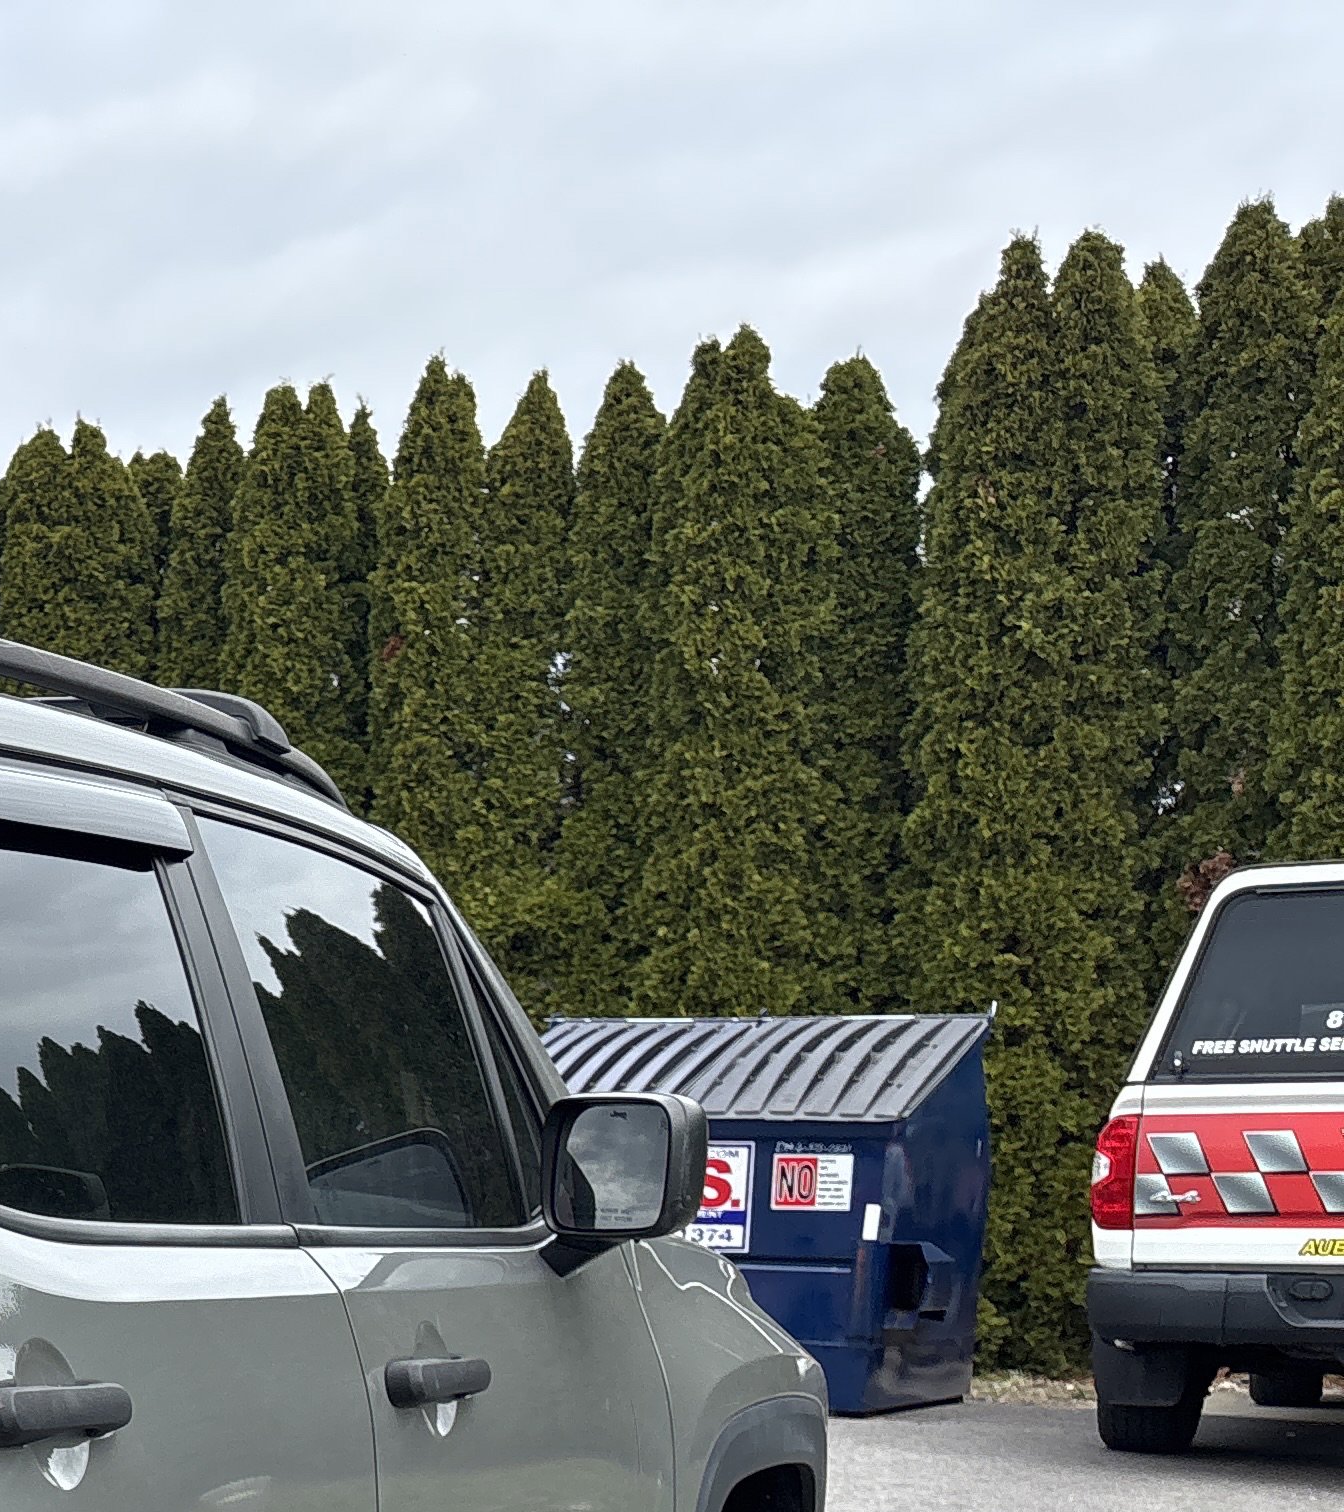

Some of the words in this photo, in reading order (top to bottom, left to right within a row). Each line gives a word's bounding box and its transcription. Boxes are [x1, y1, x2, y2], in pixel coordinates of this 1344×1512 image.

[1192, 1040, 1236, 1054] FREE
[1238, 1037, 1316, 1053] SHUTTLE
[1318, 1036, 1344, 1051] SE
[776, 1161, 815, 1202] NO
